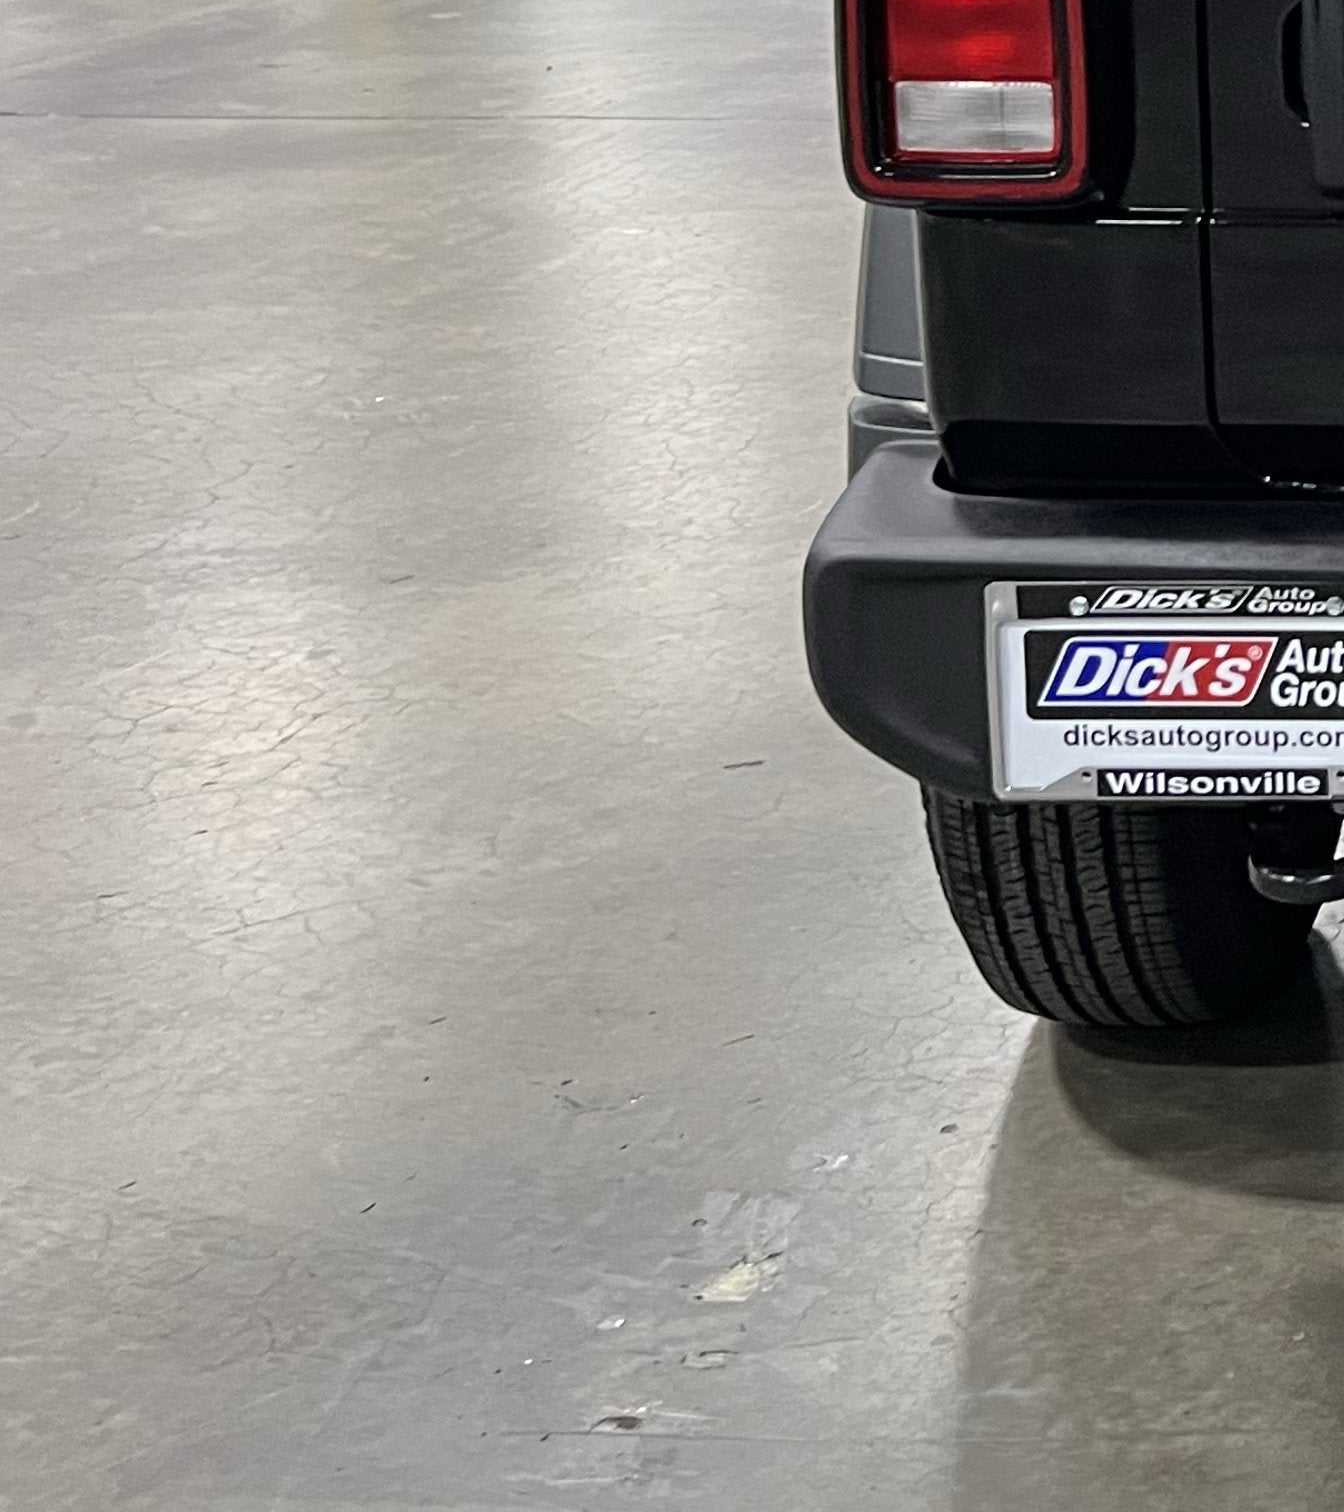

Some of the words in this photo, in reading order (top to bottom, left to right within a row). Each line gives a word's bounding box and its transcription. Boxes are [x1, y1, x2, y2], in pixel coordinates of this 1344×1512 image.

[1101, 587, 1236, 610] Dick's
[1251, 587, 1316, 601] Auto
[1248, 598, 1328, 616] Group
[1056, 642, 1251, 696] Dick's
[1105, 771, 1321, 795] Wilsonville
